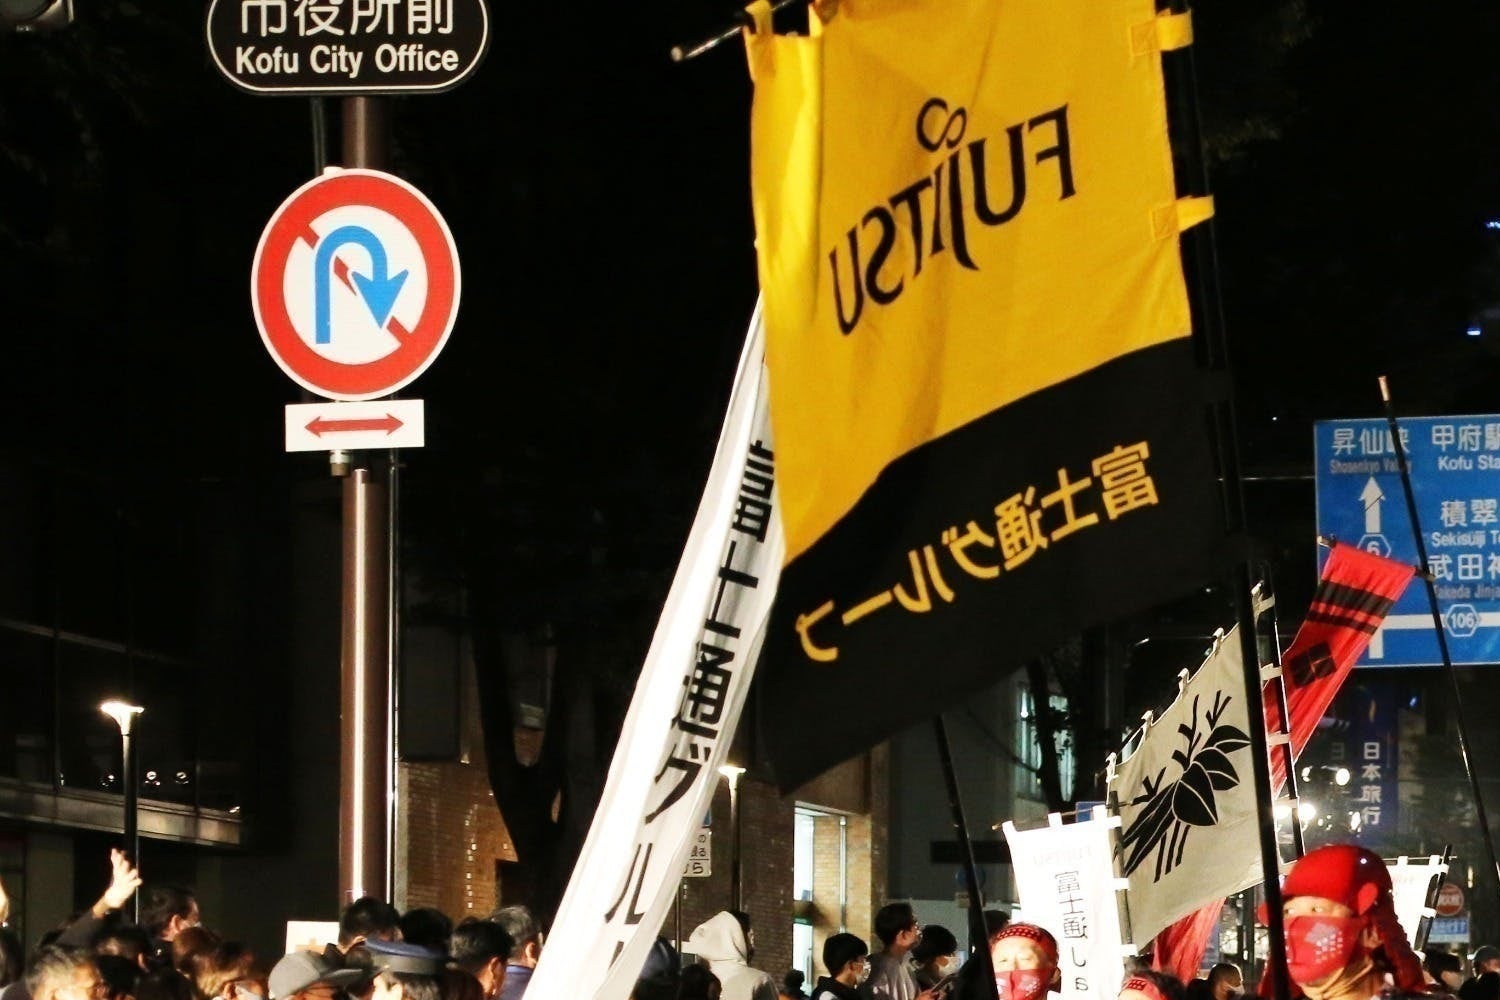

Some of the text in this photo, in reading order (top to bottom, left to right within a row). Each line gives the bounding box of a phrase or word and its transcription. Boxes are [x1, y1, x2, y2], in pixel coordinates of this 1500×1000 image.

[240, 0, 454, 36] 市役所前
[236, 44, 459, 78] Kofu City Office
[1438, 456, 1473, 471] Kofu
[1450, 612, 1477, 630] 106
[1360, 741, 1382, 825] 日本旅行
